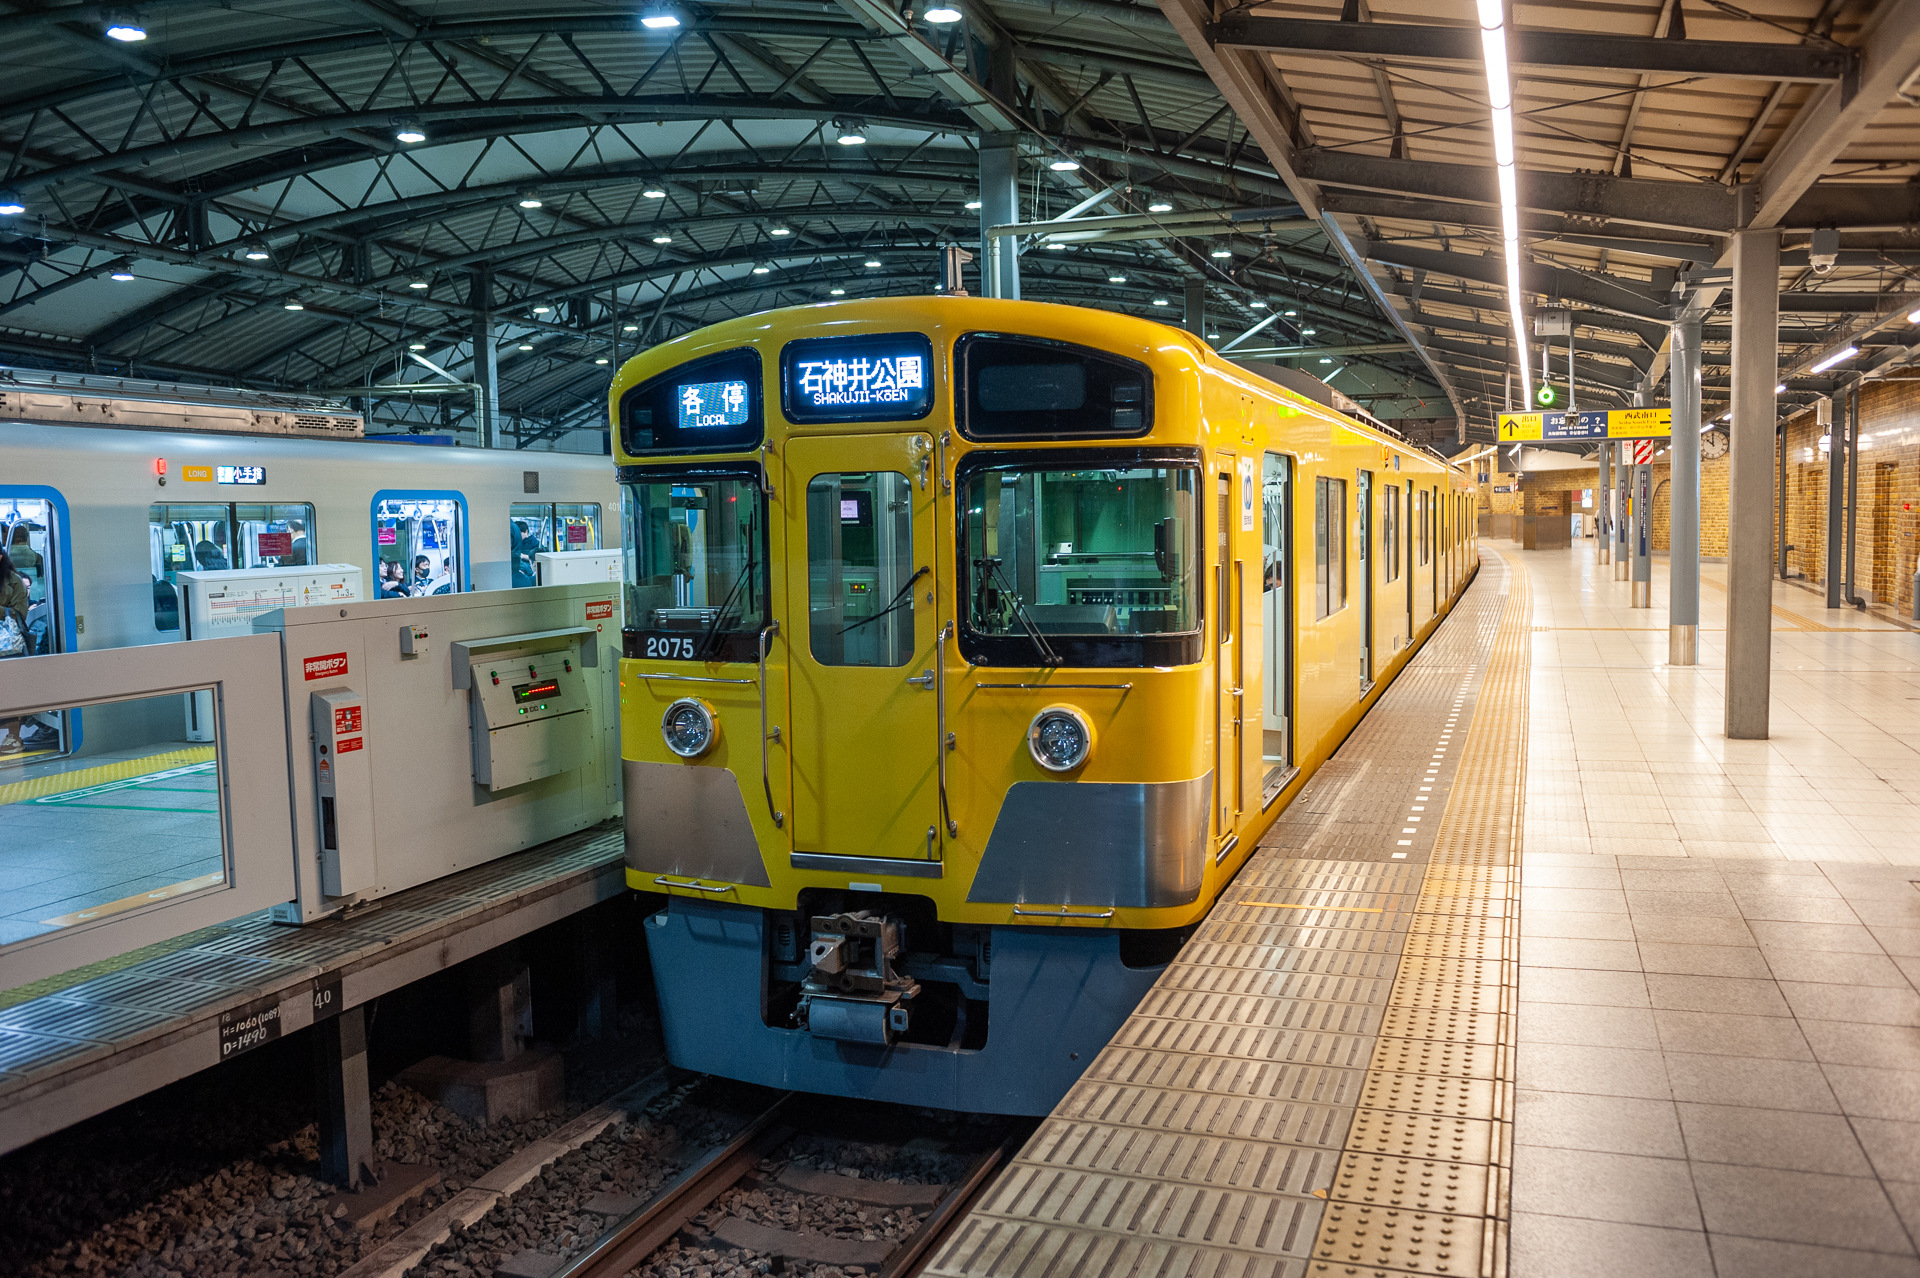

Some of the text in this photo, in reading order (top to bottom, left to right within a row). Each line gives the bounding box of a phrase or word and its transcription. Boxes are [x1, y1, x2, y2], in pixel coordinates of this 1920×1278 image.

[798, 356, 923, 394] 石神井公園
[696, 414, 729, 426] LOCAL
[188, 470, 207, 478] LONG
[647, 637, 694, 658] 2075
[314, 990, 331, 1009] 40
[223, 1027, 267, 1055] D=1490
